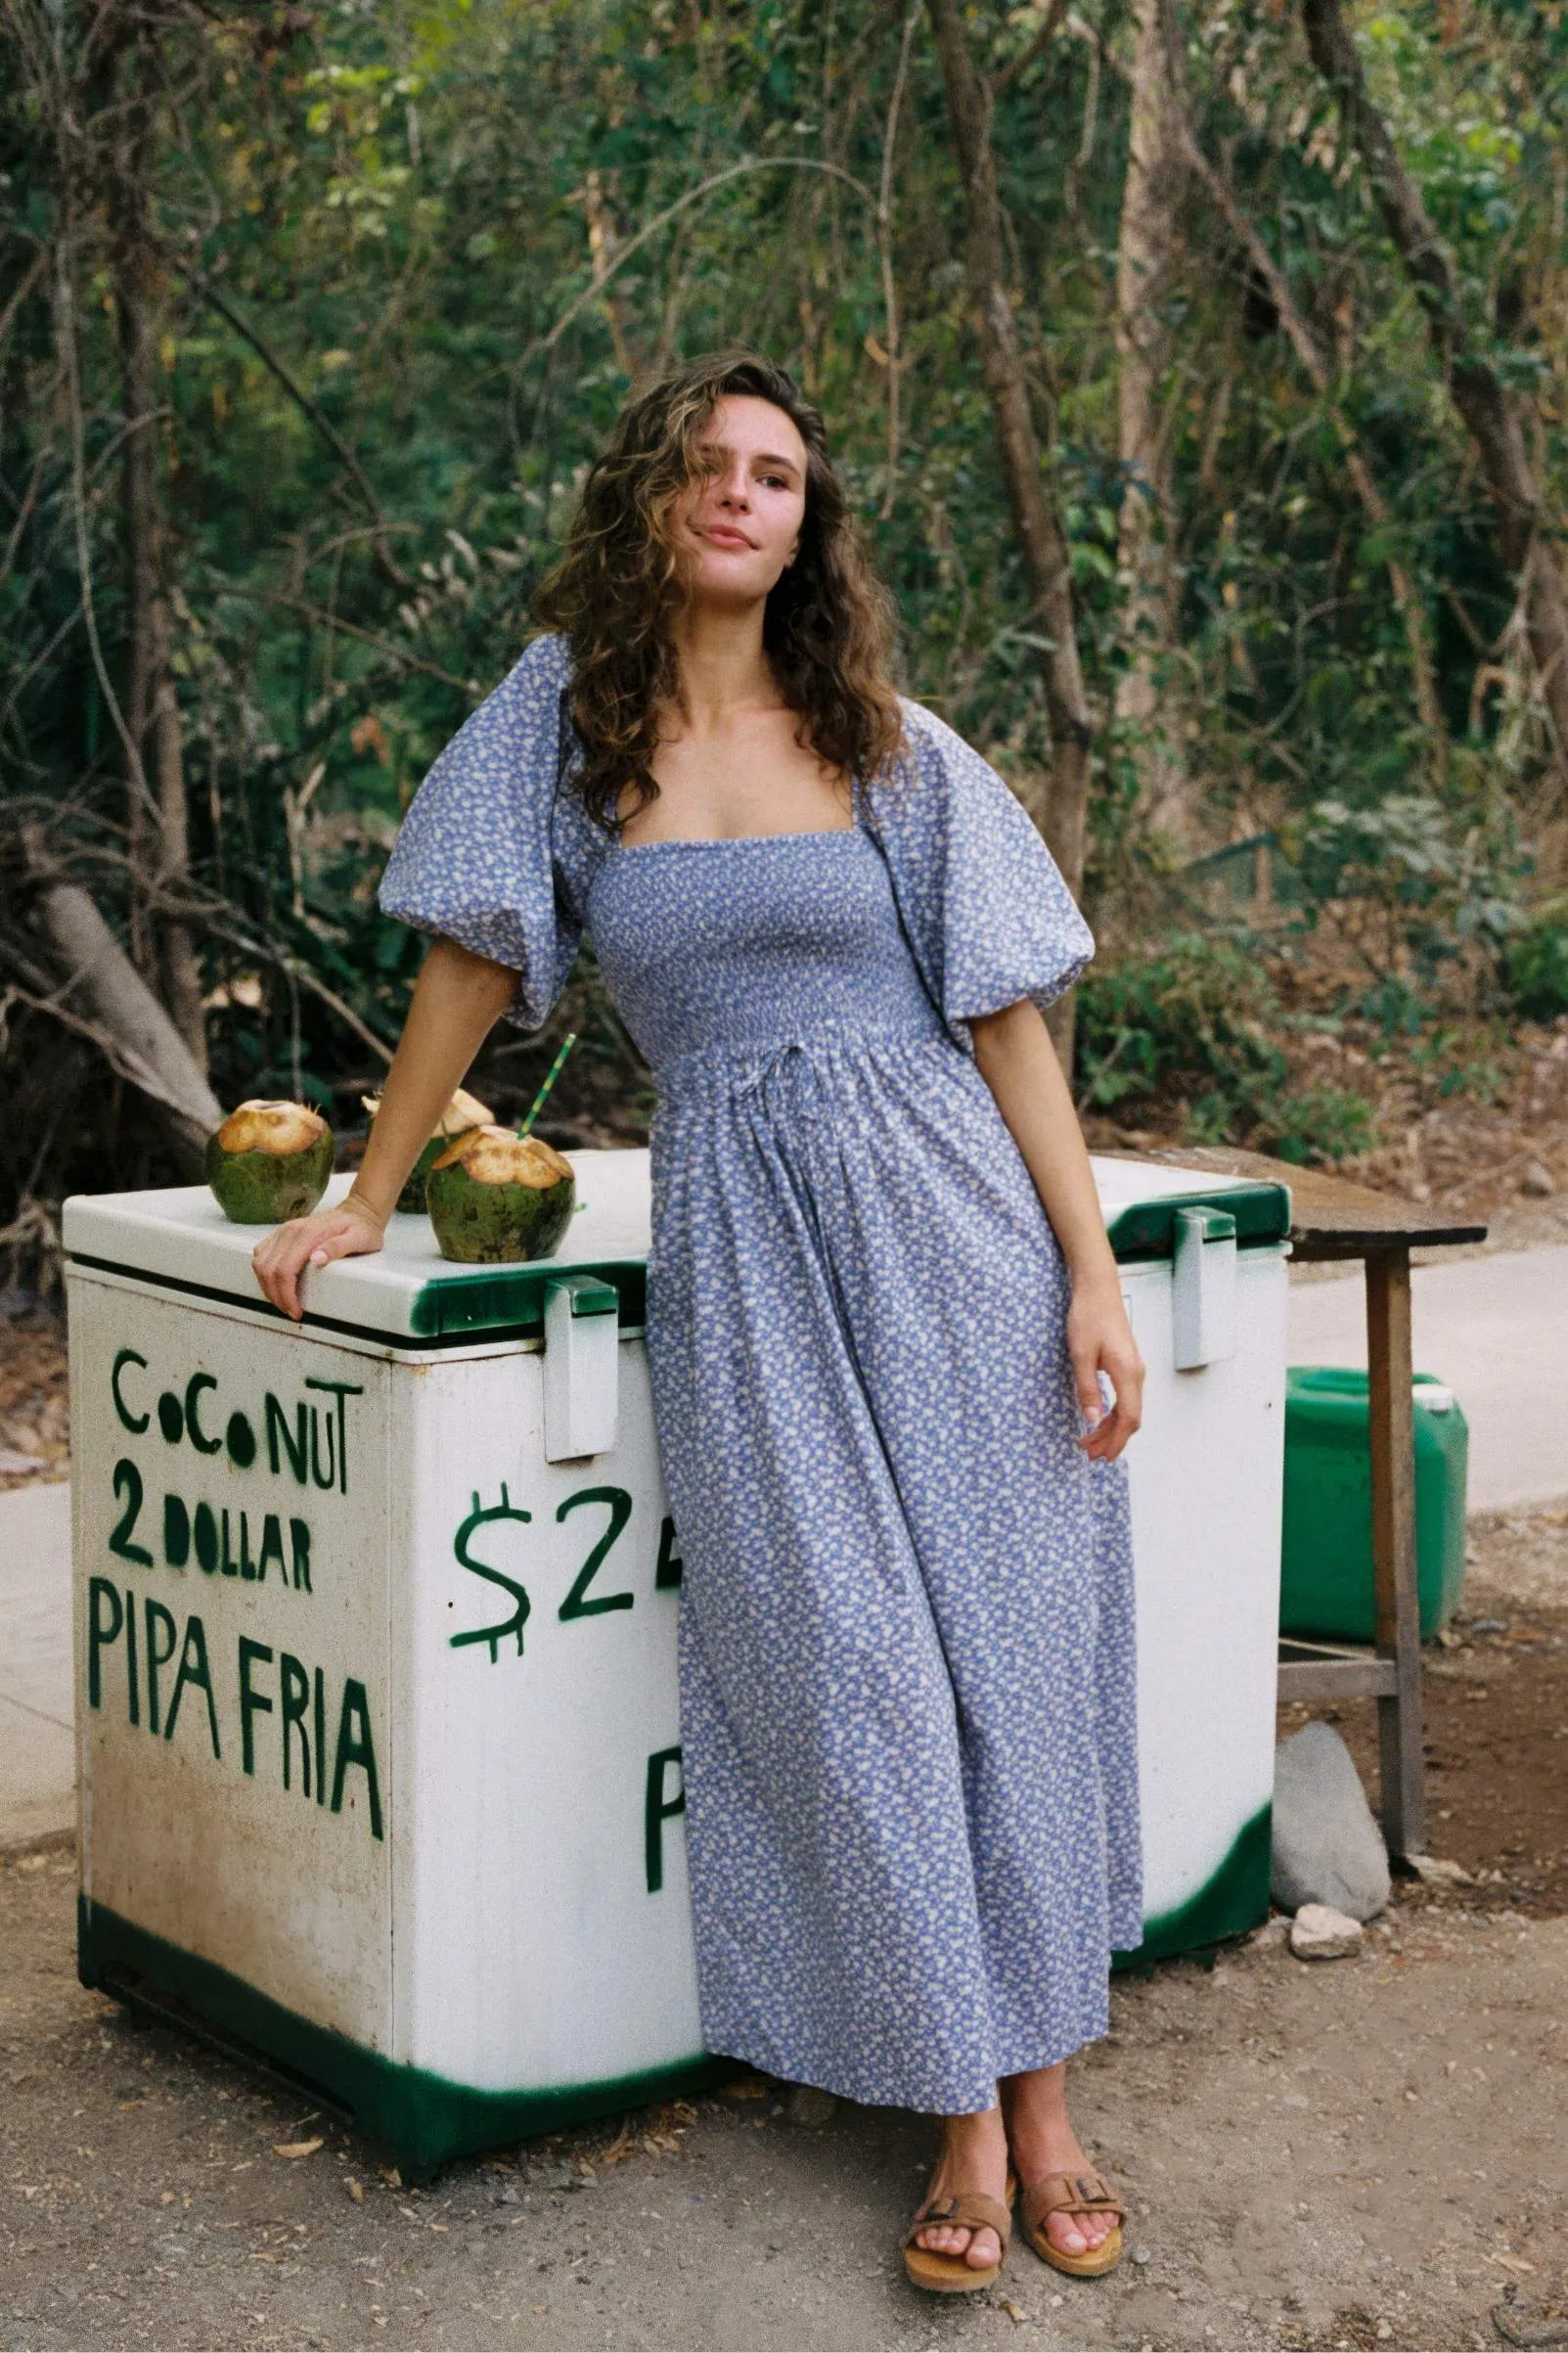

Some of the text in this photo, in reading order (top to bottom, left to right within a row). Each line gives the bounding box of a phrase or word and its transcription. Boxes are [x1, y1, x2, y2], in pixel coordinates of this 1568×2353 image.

[108, 1457, 313, 1595] 2 DOLLAR
[88, 1576, 384, 1843] PIPA FRIA
